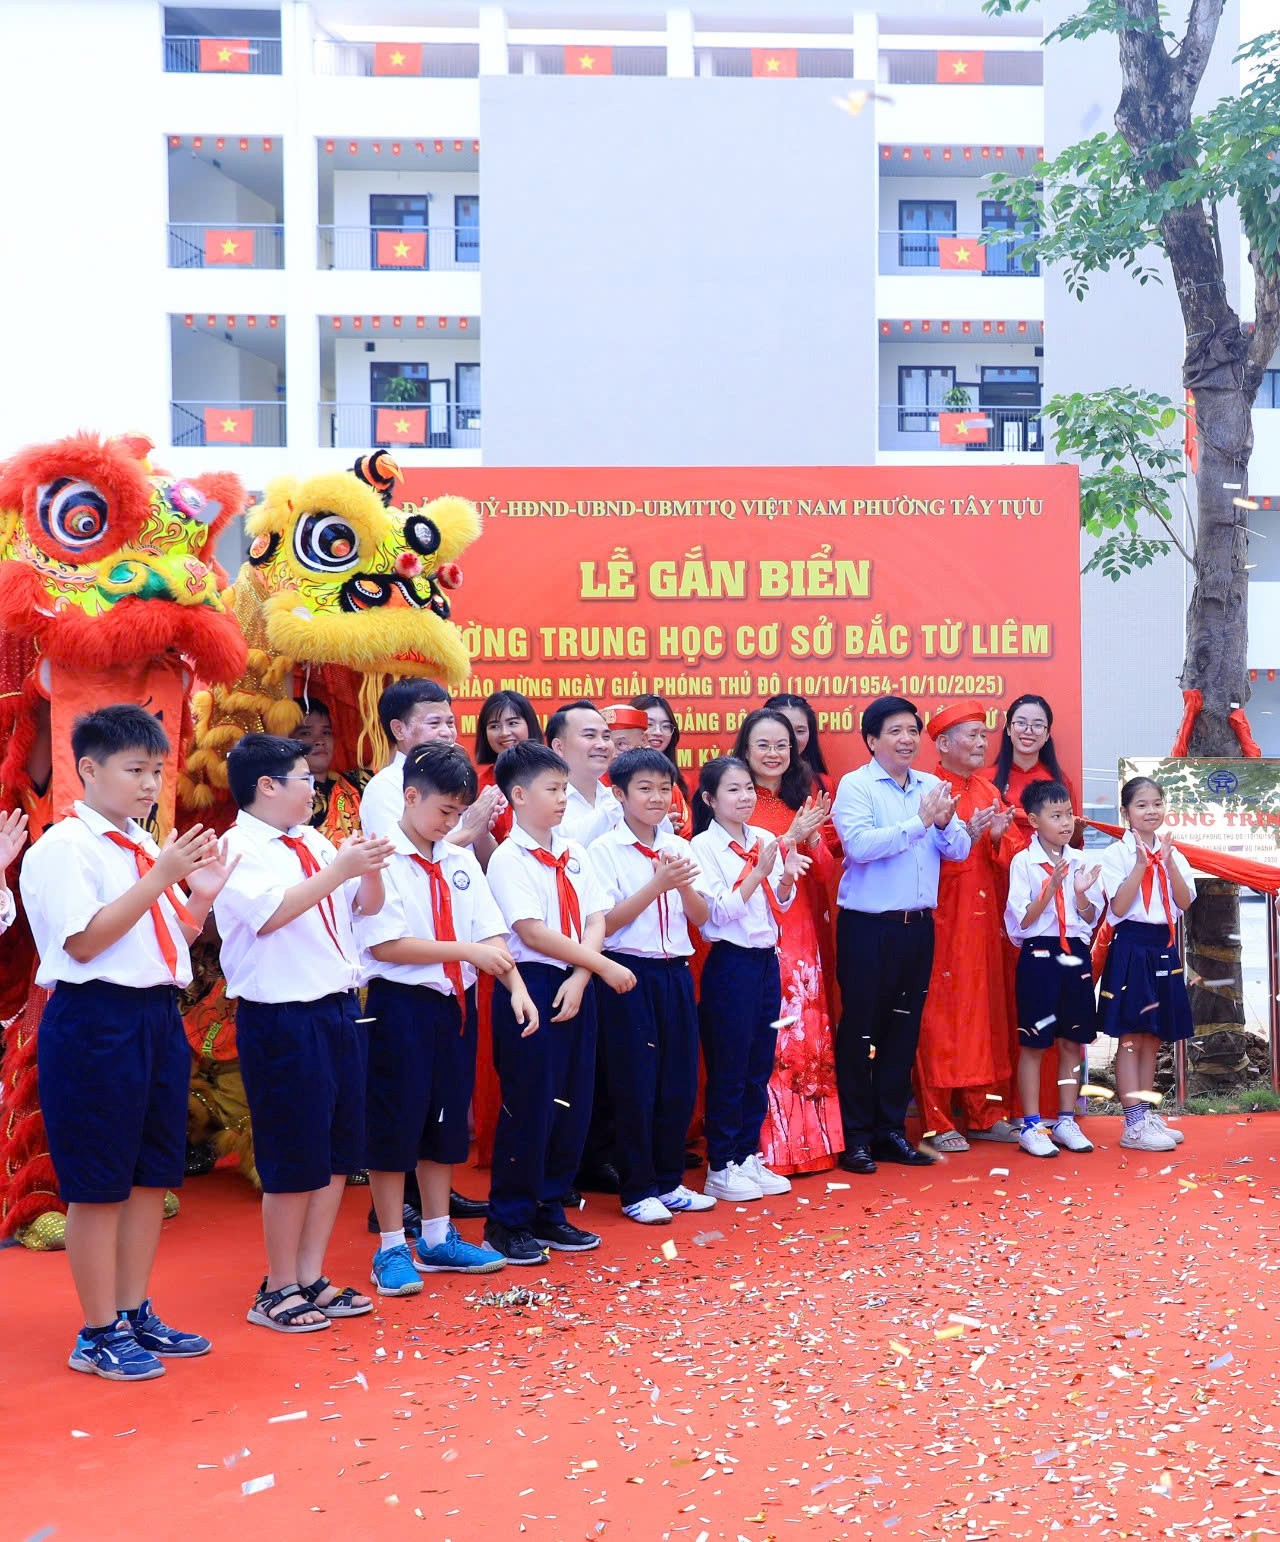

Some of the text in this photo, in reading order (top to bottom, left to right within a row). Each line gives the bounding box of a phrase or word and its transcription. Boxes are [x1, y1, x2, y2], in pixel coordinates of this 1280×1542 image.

[741, 497, 793, 520] VIỆT
[797, 499, 848, 516] NAM
[852, 494, 945, 516] PHƯỜNG
[950, 494, 994, 516] TÂY
[998, 496, 1043, 520] TỰU
[580, 543, 871, 598] LỄ GẮN BIỂN
[540, 626, 646, 657] TRUNG
[660, 625, 724, 663] HỌC
[736, 622, 779, 656] CƠ
[790, 615, 833, 655] SỞ
[845, 614, 909, 655] BẮC
[921, 618, 964, 655] TỪ
[973, 618, 1049, 655] LIÊM
[501, 674, 552, 697] MỪNG
[559, 673, 605, 697] NGÀY
[612, 671, 647, 697] GIẢI
[653, 672, 713, 697] PHÓNG
[719, 669, 751, 696] THỦ
[757, 672, 781, 696] ĐÔ
[787, 673, 1004, 697] (10/10/1954-10/10/2025)
[818, 704, 853, 731] PHỐ
[1164, 808, 1217, 828] ÔNG
